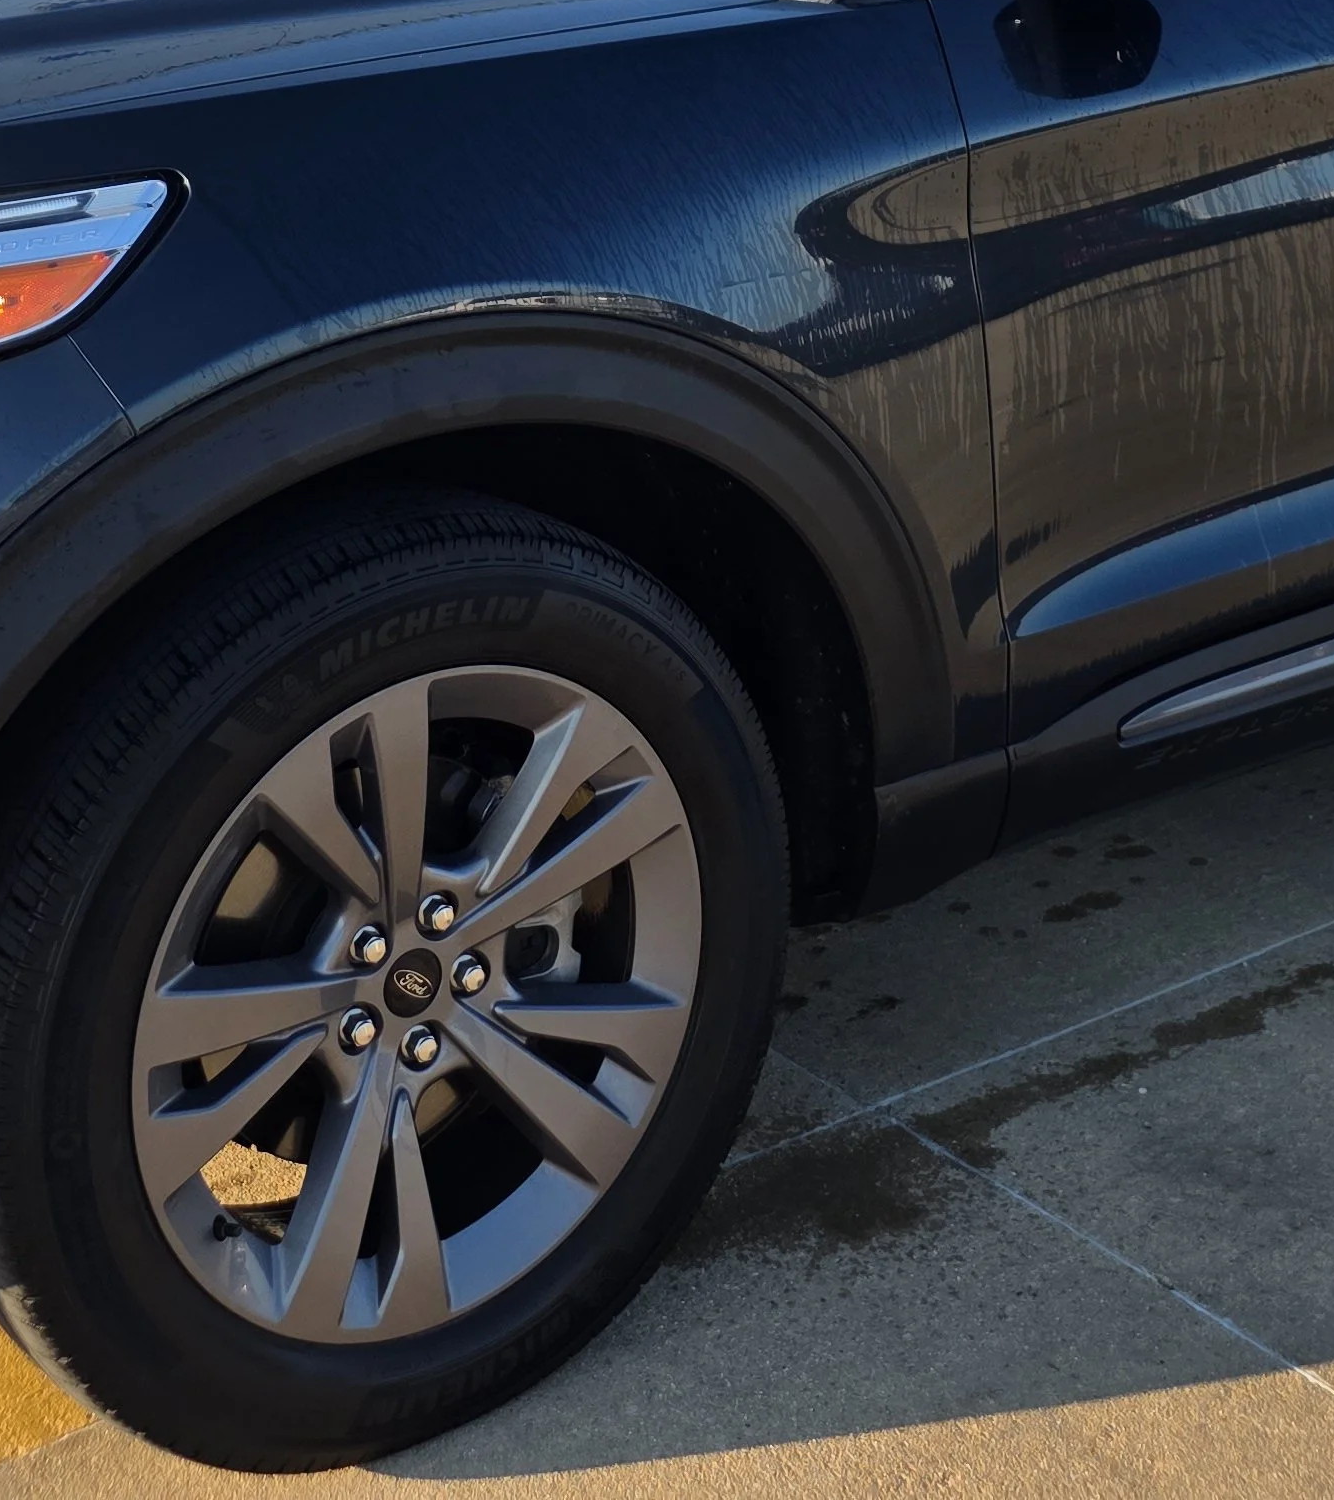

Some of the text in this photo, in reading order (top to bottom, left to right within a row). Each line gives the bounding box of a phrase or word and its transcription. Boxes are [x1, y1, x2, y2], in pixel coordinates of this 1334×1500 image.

[318, 595, 531, 682] MICHELIN
[564, 601, 660, 658] PRIMACY
[399, 973, 427, 995] Ford
